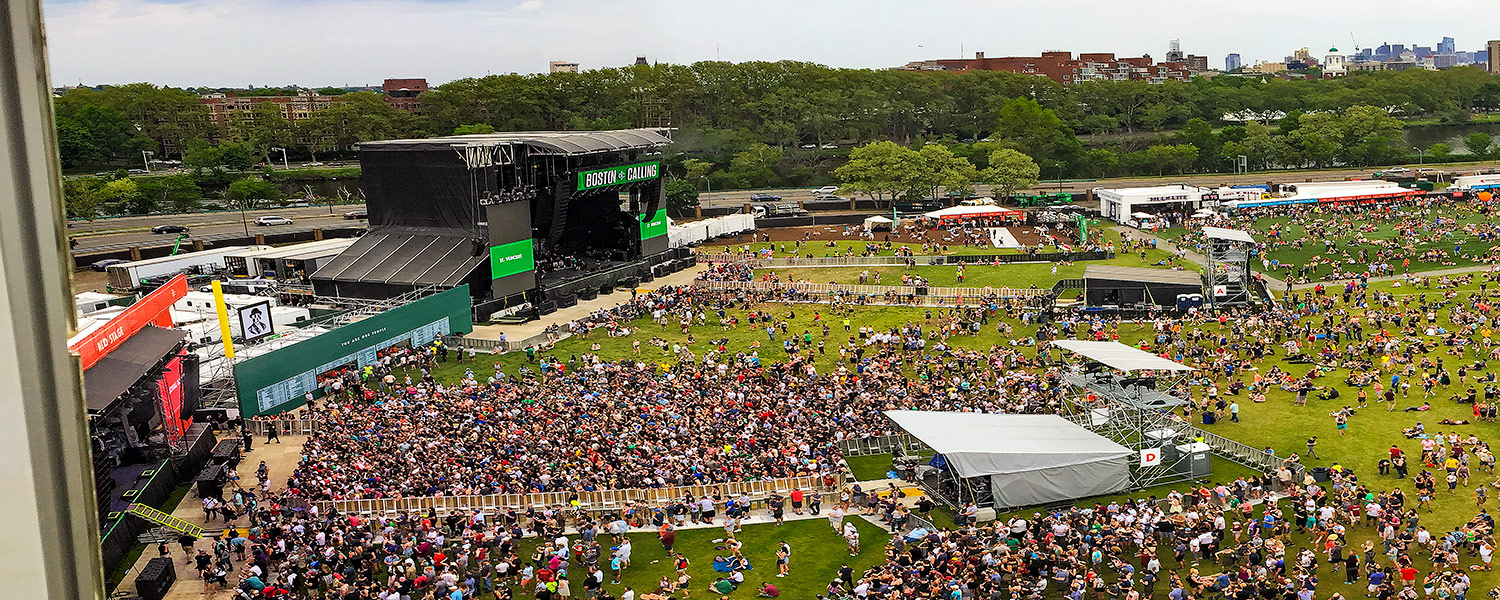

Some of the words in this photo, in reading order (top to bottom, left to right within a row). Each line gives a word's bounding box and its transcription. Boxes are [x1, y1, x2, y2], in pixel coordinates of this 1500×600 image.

[585, 170, 616, 187] BOSTON
[627, 164, 657, 181] CALLING
[109, 326, 125, 344] STAGE
[1146, 453, 1156, 462] D
